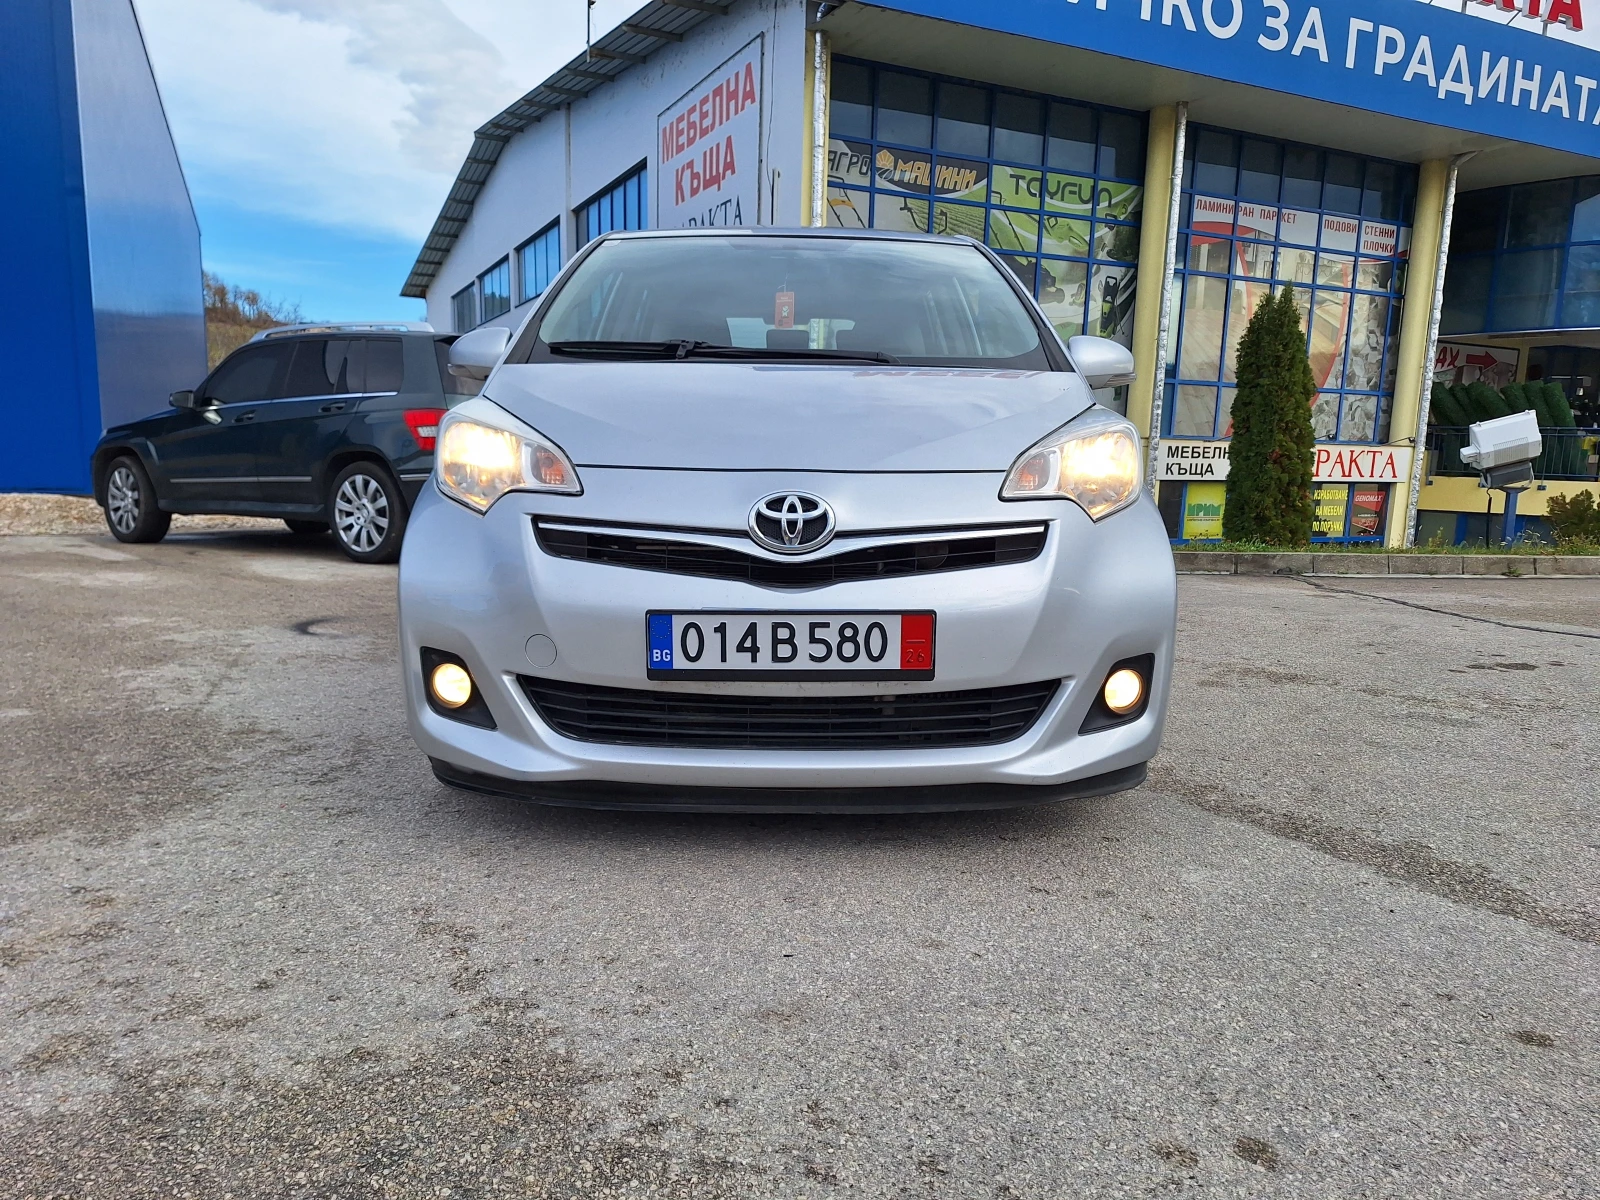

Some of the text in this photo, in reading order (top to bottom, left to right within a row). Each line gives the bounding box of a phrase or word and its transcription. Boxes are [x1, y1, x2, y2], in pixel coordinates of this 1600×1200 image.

[1257, 0, 1329, 62] ЗА
[1345, 17, 1600, 126] ГРАДИНАТ
[662, 61, 756, 164] МЕБЕЛНА
[675, 134, 736, 206] КЪЩА
[828, 149, 871, 175] АГРО
[1010, 174, 1112, 207] TAYFUN
[1260, 209, 1298, 224] ПАРКЕТ
[1324, 219, 1395, 239] ПОДОВИ СТЕННИ
[1363, 240, 1396, 253] ПЛОЧКИ
[1165, 463, 1215, 478] КЪЩА
[1313, 449, 1398, 478] РАКТА
[1314, 489, 1349, 500] ИЗРАБОТВАНЕ
[653, 621, 925, 663] BG 014B580 26
